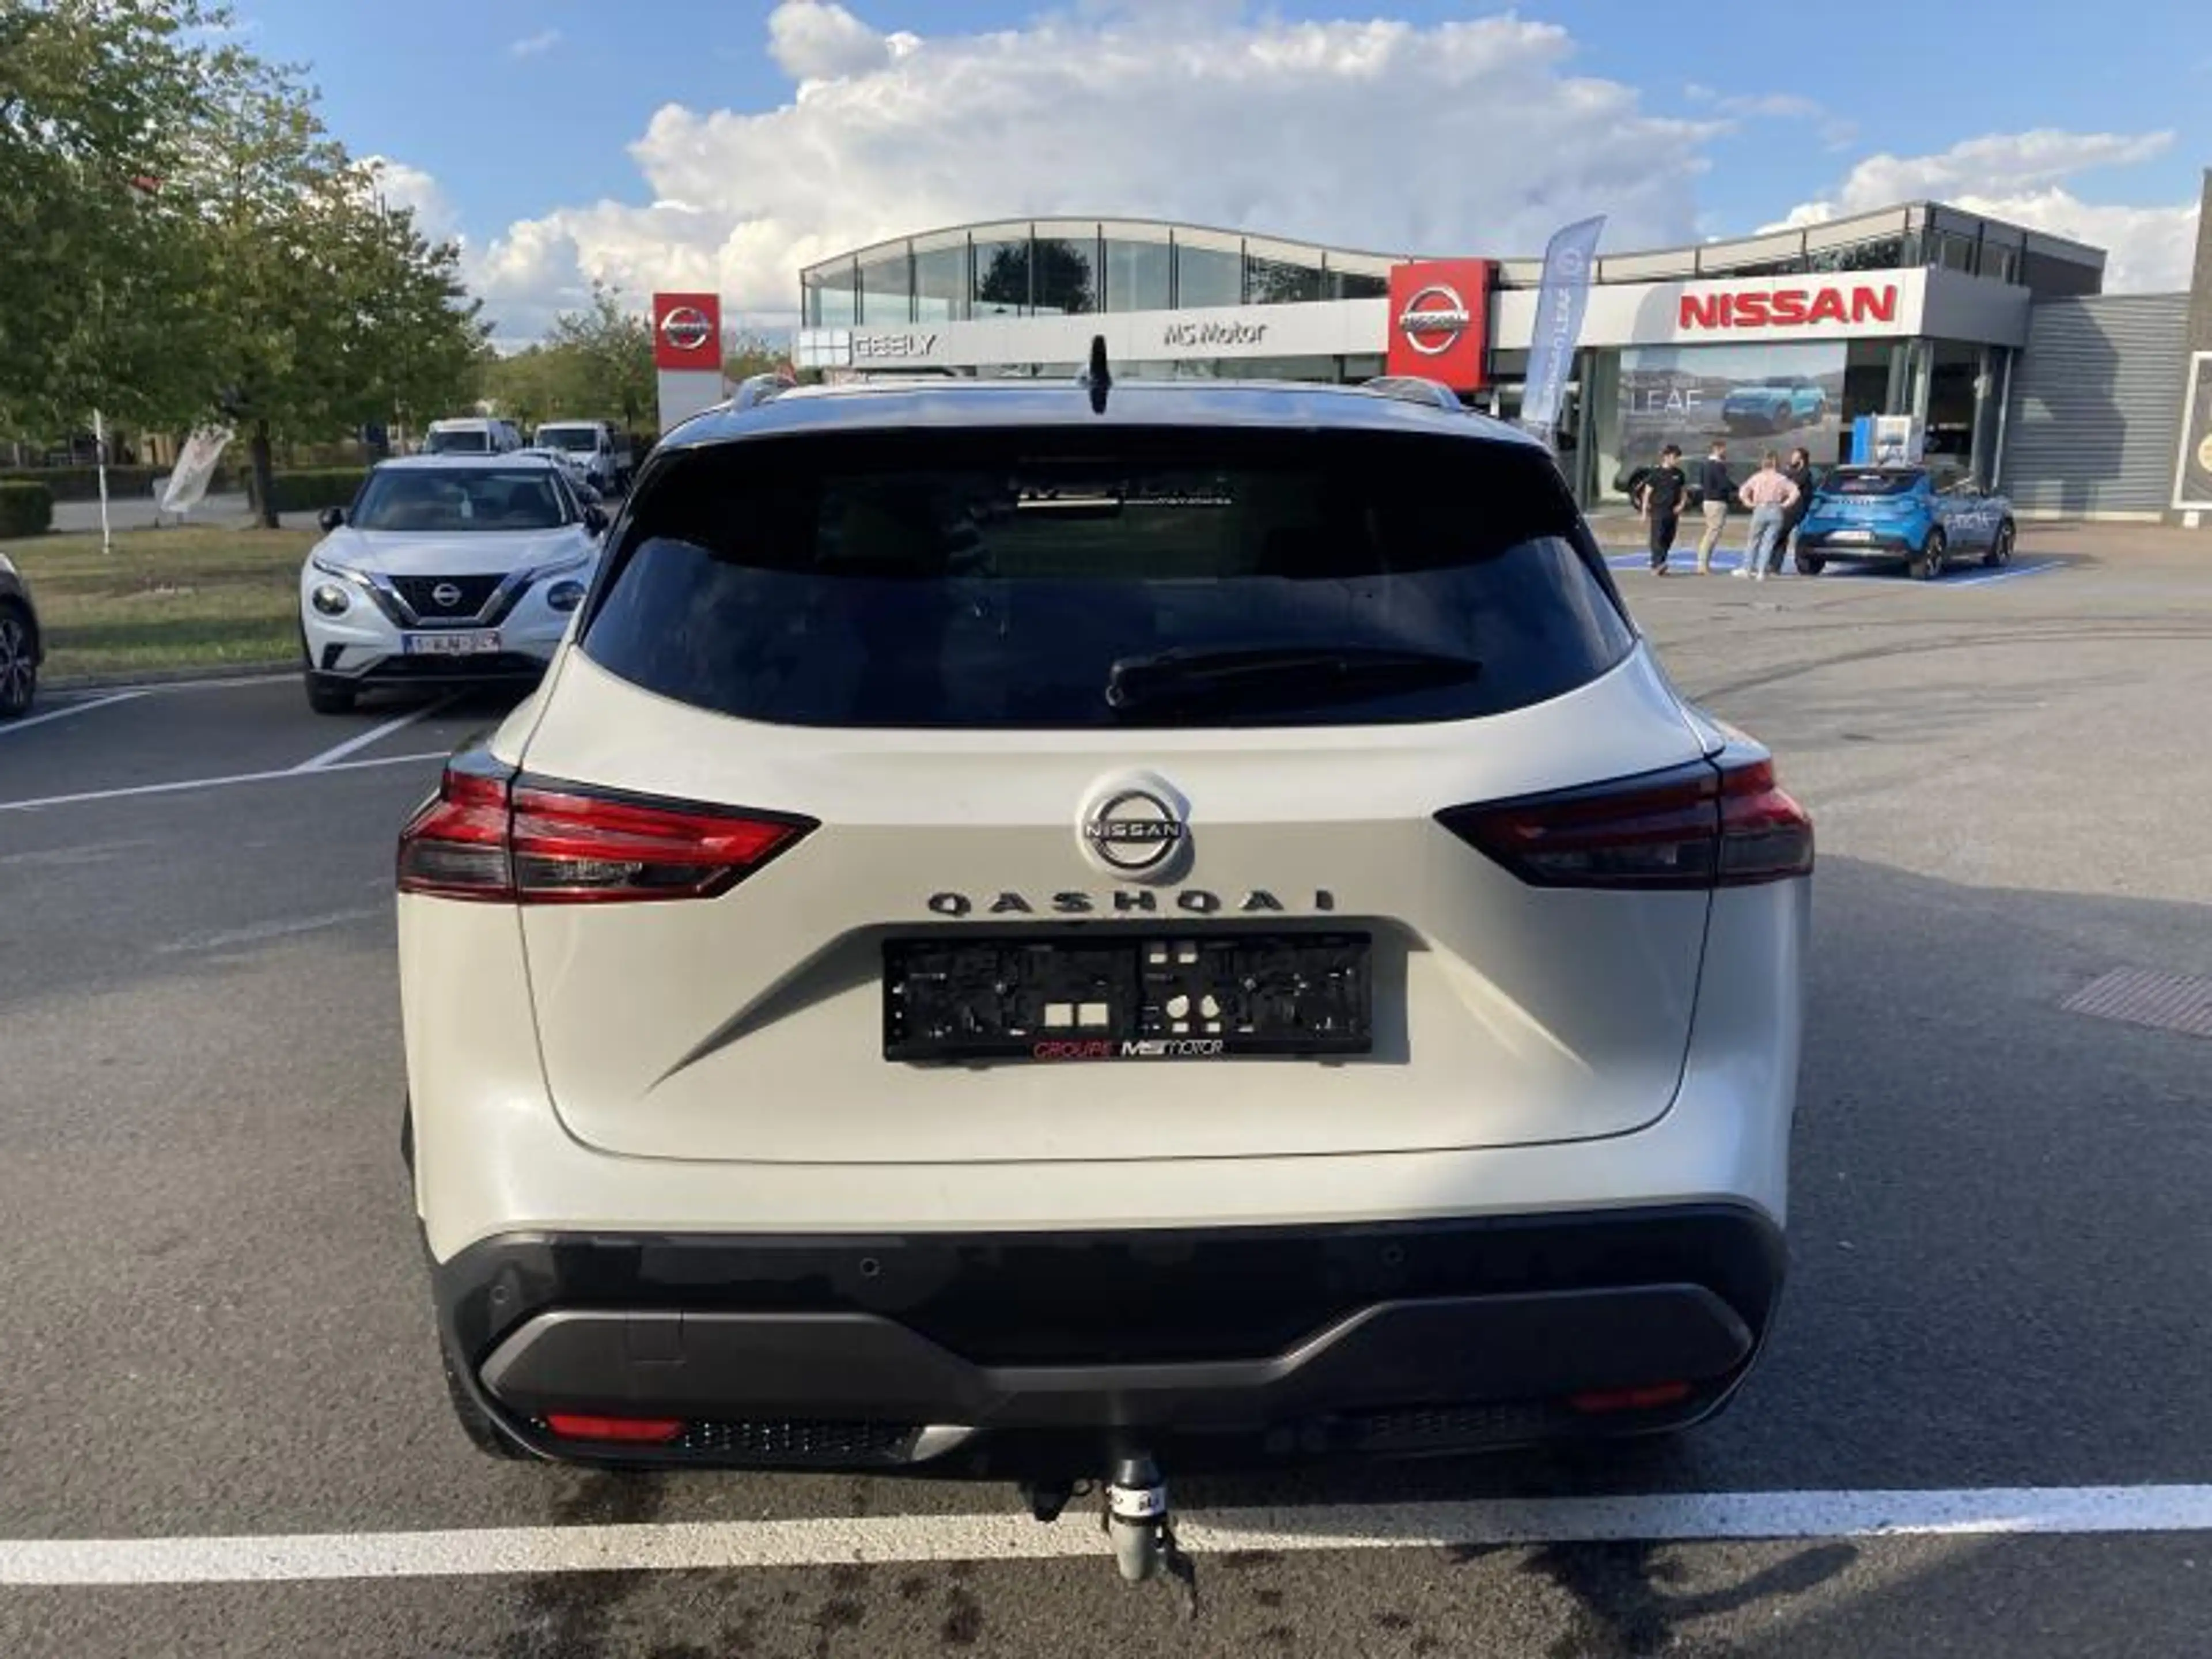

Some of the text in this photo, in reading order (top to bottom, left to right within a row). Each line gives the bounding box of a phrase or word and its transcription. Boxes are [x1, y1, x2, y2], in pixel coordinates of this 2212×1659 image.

[1679, 285, 1899, 329] NISSAN
[1164, 320, 1268, 345] MS Motor
[855, 334, 937, 357] GEELY
[1630, 388, 1704, 416] LEAF
[1085, 823, 1180, 838] NISSAN
[927, 890, 1334, 917] QASHQAI
[1034, 1040, 1113, 1058] GROUPE
